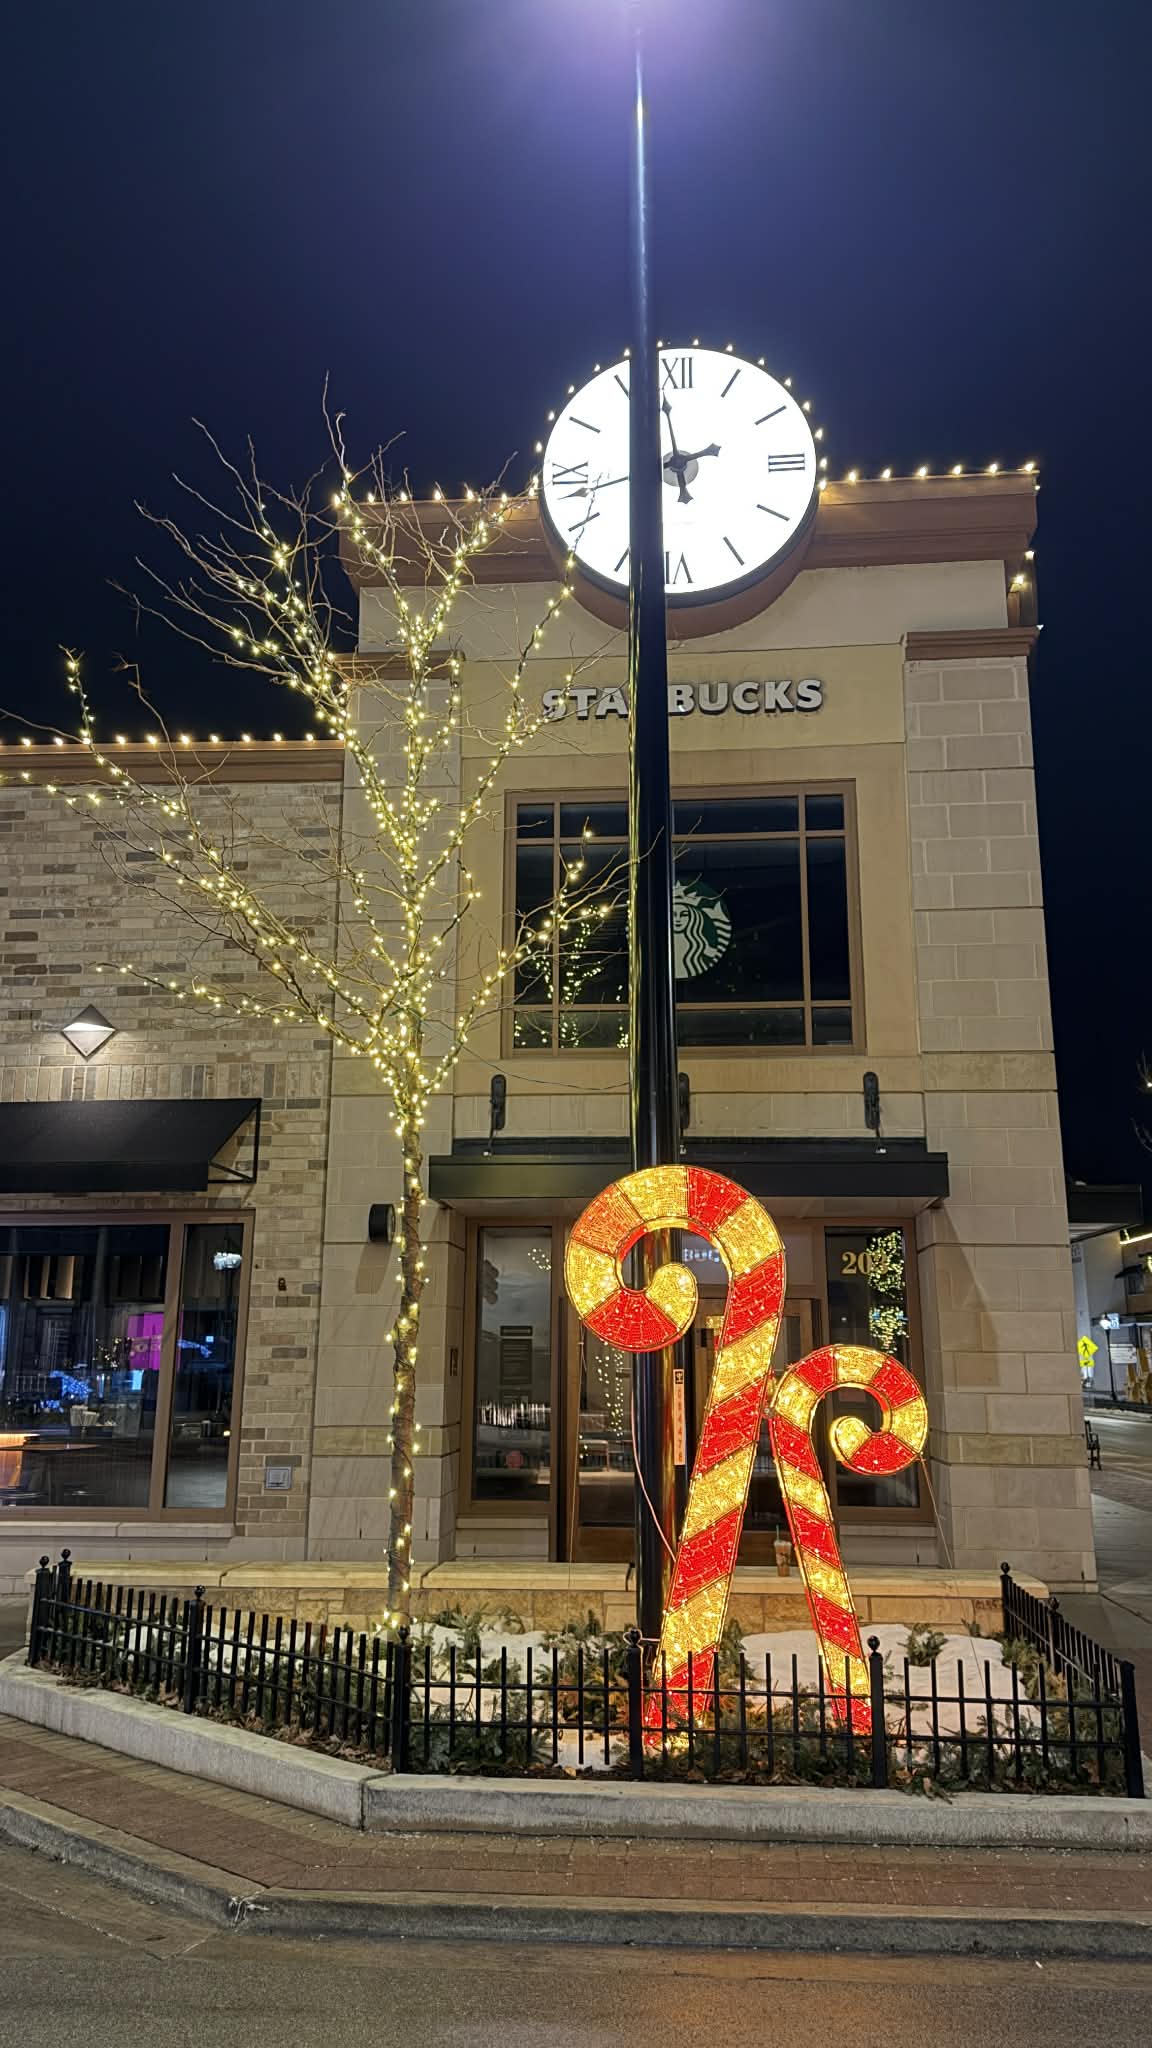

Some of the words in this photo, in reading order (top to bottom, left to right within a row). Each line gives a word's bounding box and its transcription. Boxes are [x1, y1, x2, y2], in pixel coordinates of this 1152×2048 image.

[661, 357, 693, 389] XII
[552, 461, 588, 485] IX
[768, 453, 805, 472] III
[542, 679, 824, 721] STABUCKS
